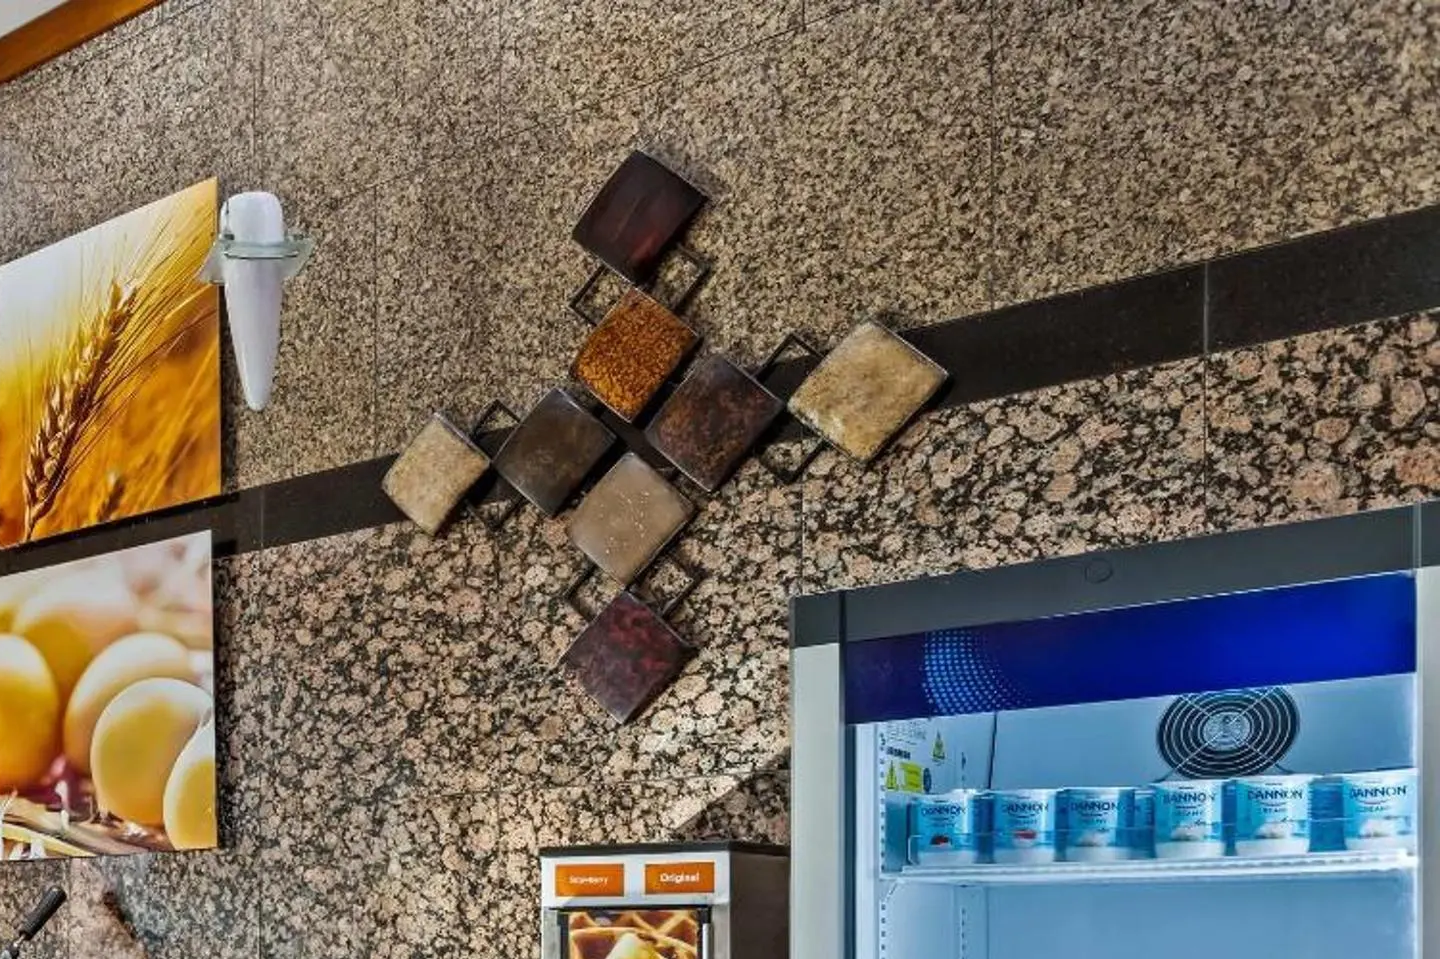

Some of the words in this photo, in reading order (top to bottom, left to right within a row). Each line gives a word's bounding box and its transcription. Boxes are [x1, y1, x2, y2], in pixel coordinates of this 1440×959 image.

[1164, 791, 1215, 804] DANNON
[1247, 788, 1303, 801] DANNON
[1351, 785, 1407, 799] DANNON
[660, 872, 700, 884] Original
